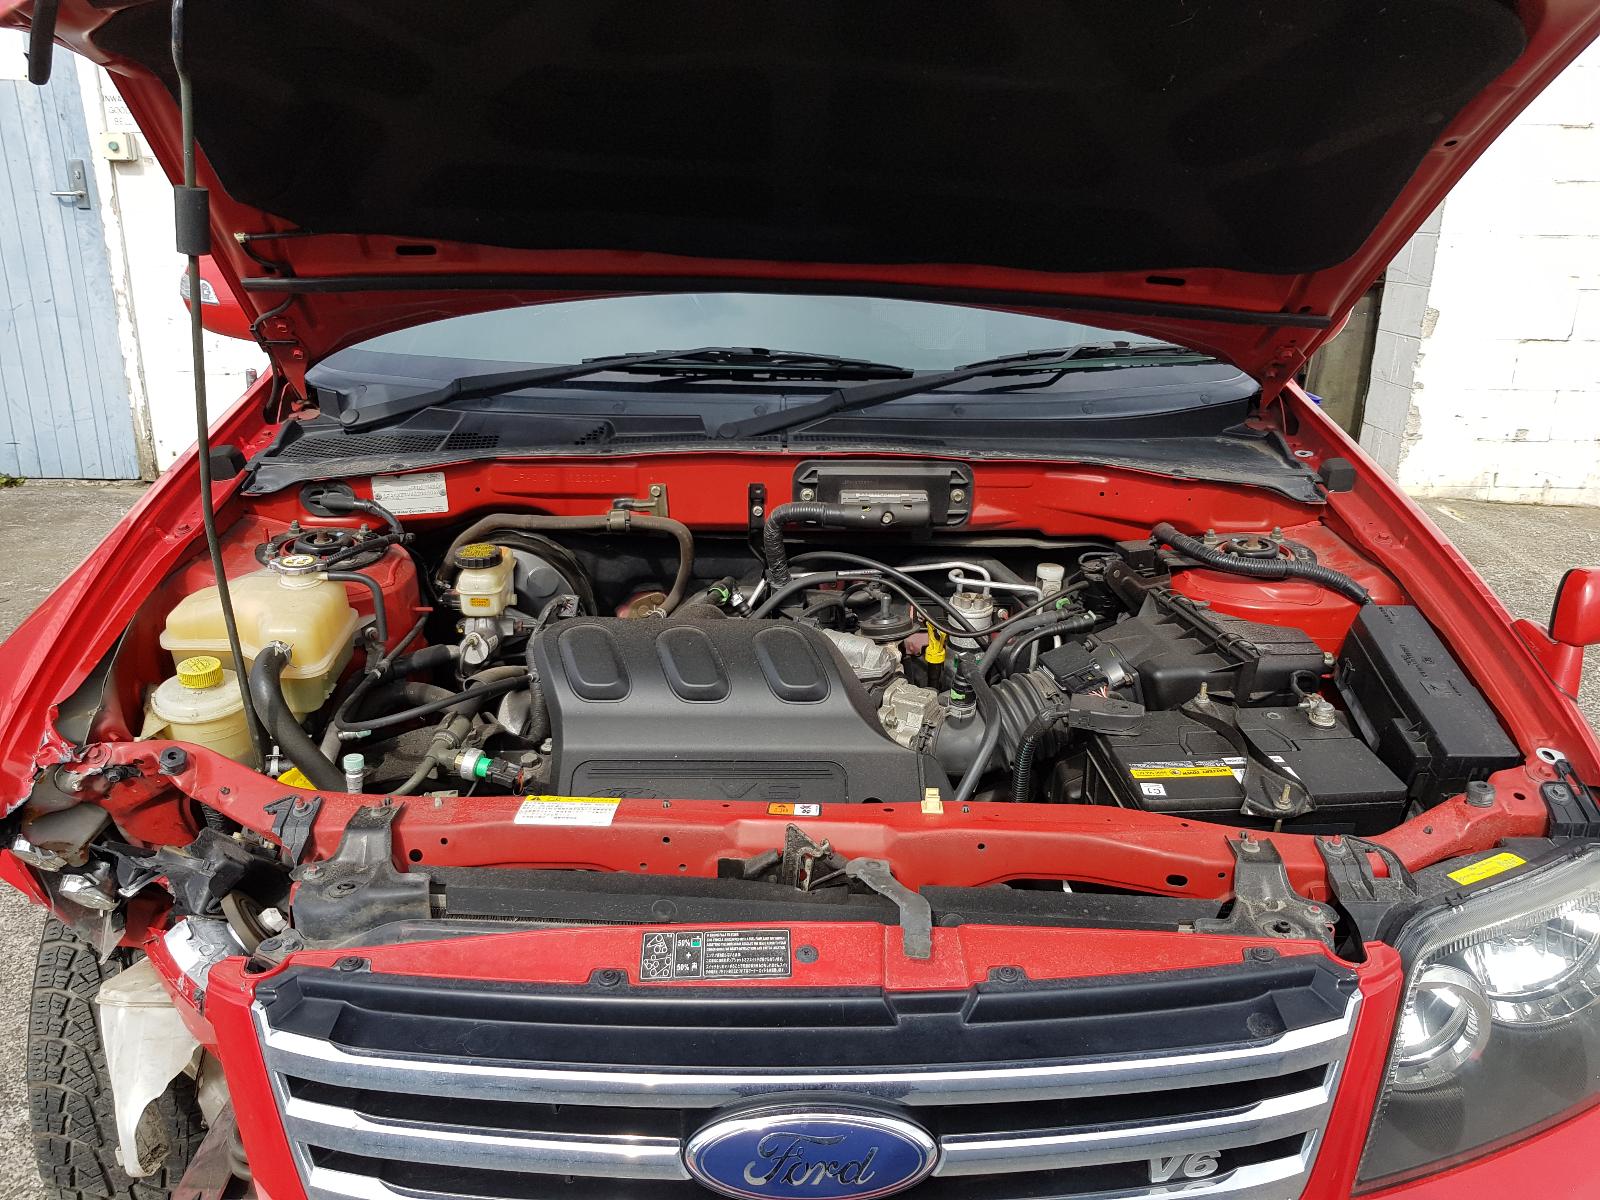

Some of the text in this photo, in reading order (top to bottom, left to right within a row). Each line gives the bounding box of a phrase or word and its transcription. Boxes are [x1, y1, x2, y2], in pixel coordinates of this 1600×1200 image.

[677, 939, 691, 947] 50%
[676, 963, 690, 971] 50%
[743, 1131, 879, 1186] Ford
[1147, 1150, 1222, 1183] V6
